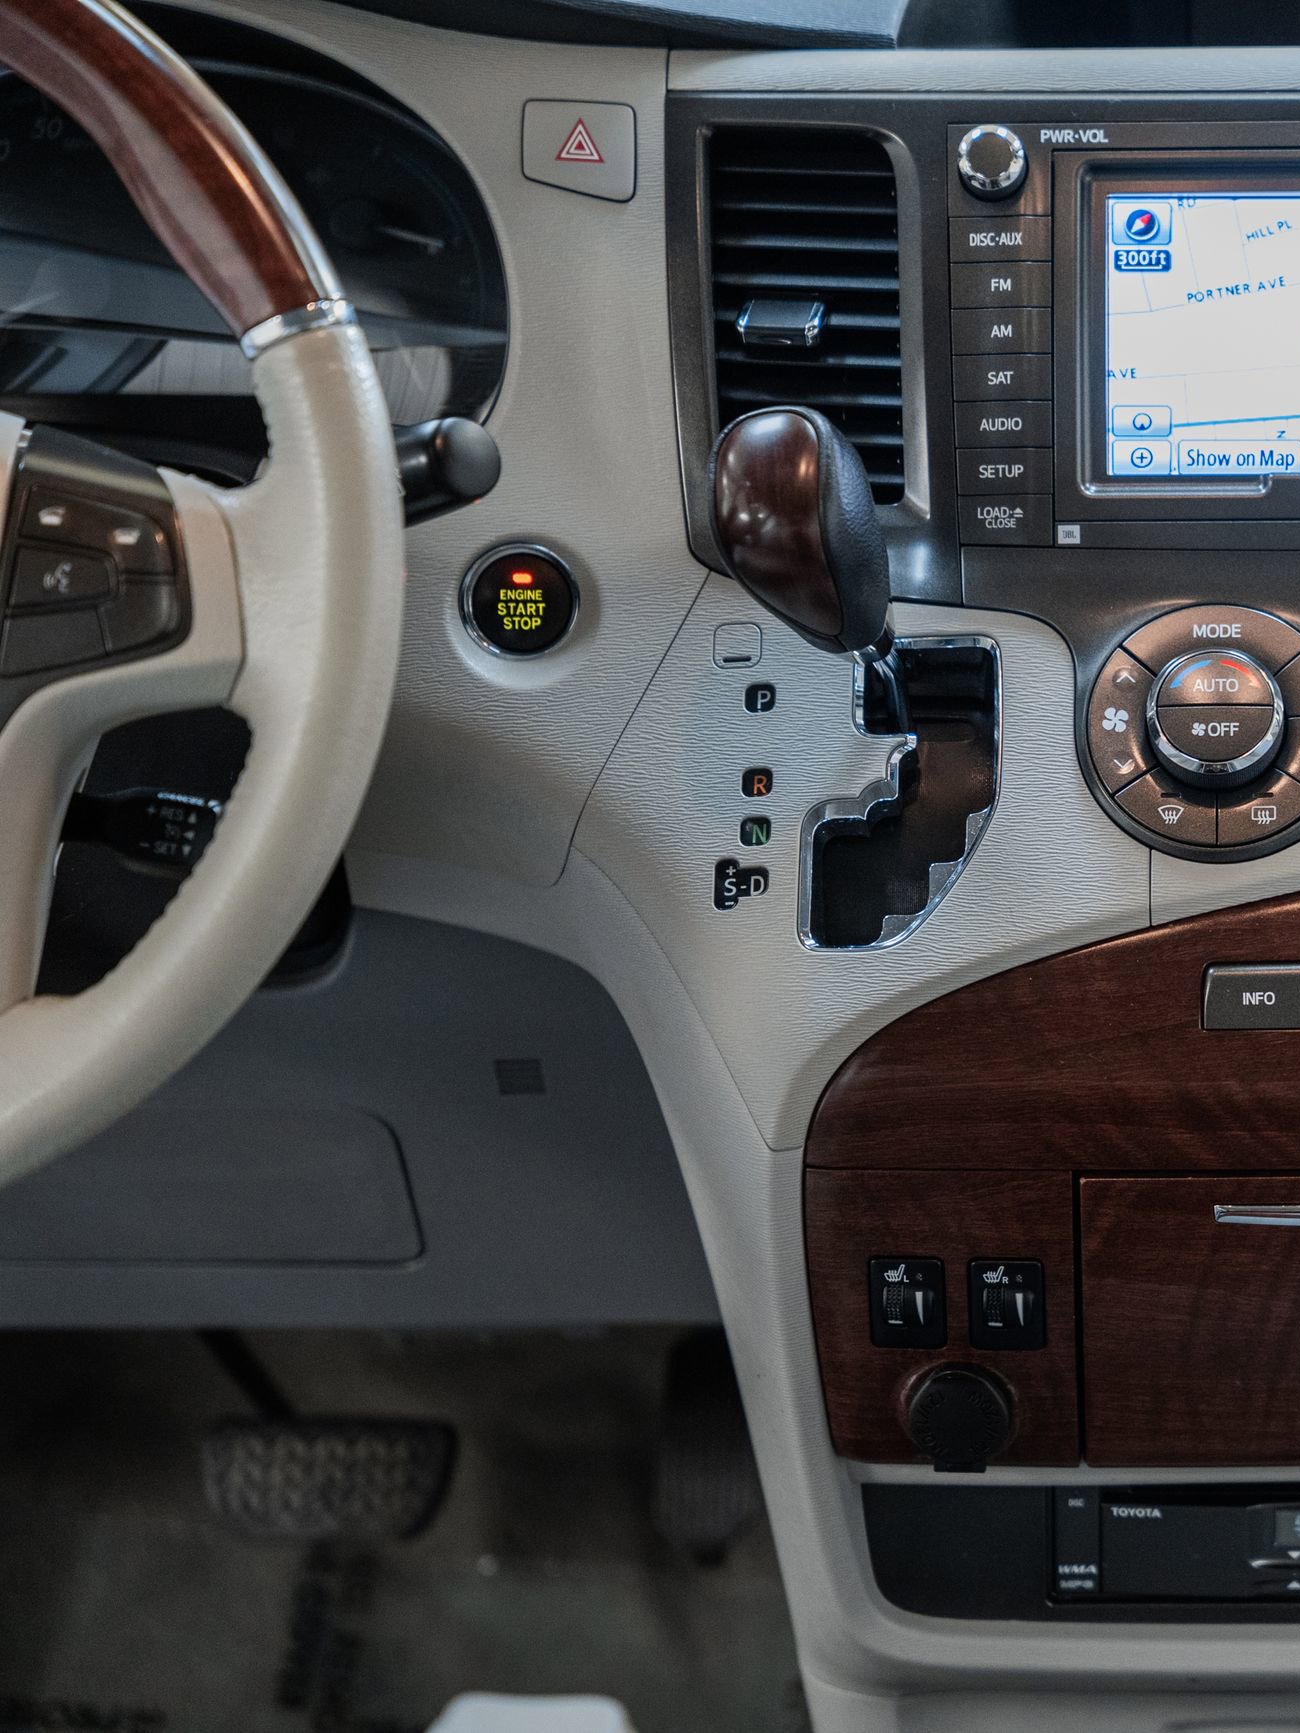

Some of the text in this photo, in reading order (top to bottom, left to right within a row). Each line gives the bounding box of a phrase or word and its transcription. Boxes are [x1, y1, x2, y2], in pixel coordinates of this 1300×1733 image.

[1245, 219, 1292, 242] HILL PL
[1117, 251, 1167, 265] 300ft
[991, 278, 1012, 292] FM
[1187, 276, 1286, 304] PORTNER AVE
[991, 324, 1012, 338] AM
[987, 371, 1014, 385] SAT
[1107, 367, 1137, 380] AVE
[980, 417, 1022, 431] AUDIO
[1187, 449, 1295, 470] Show on Map
[979, 465, 1024, 478] SETUP
[985, 518, 1016, 528] CLOSE
[1062, 529, 1077, 539] JBL
[500, 589, 543, 600] ENGINE
[497, 603, 546, 615] START
[503, 617, 541, 630] STOP
[1192, 624, 1241, 638] MODE
[1193, 678, 1239, 693] AUTO
[756, 690, 771, 709] P
[1207, 722, 1240, 737] OFF
[753, 775, 768, 794] R
[752, 823, 768, 843] N
[1242, 991, 1276, 1006] INFO
[903, 1275, 910, 1283] L
[1002, 1276, 1009, 1284] R
[1110, 1507, 1163, 1519] TOYOTA
[1058, 1564, 1098, 1575] WMA
